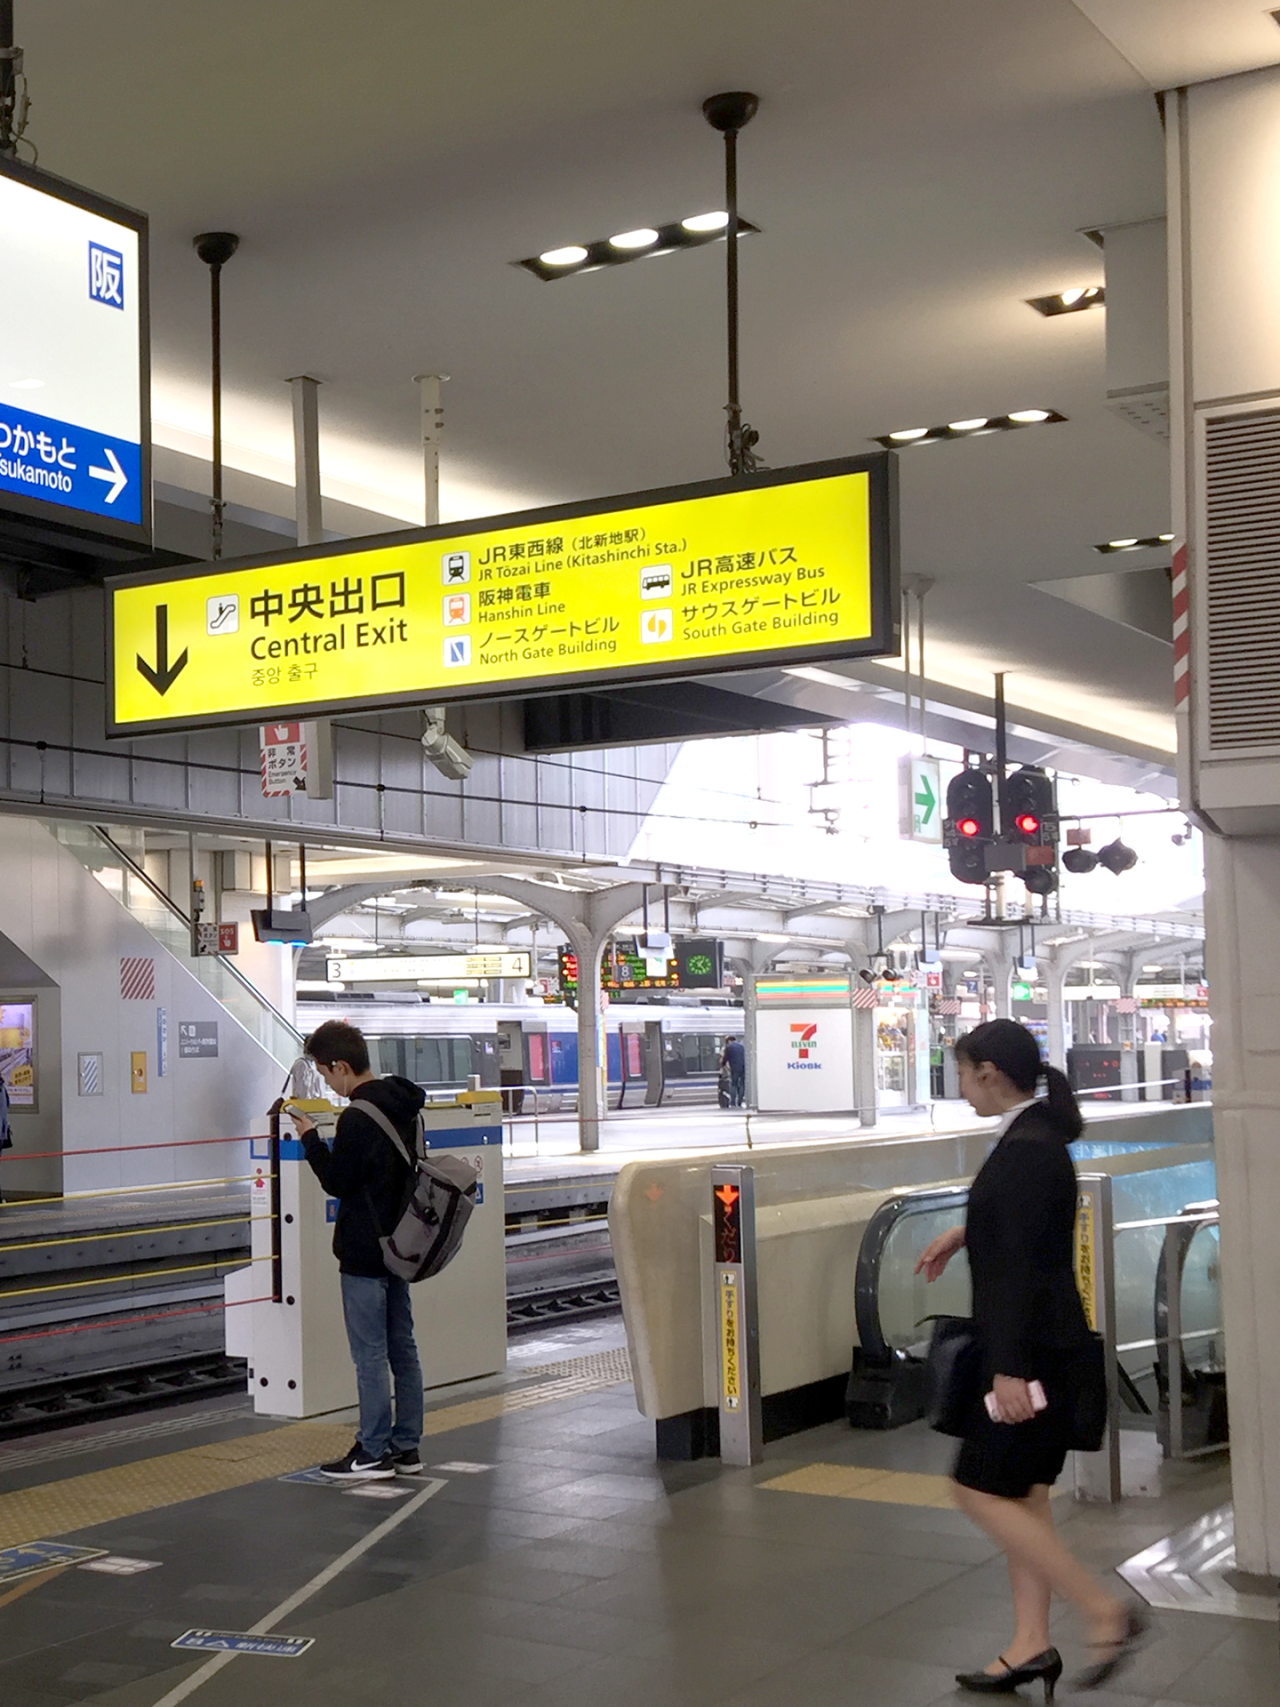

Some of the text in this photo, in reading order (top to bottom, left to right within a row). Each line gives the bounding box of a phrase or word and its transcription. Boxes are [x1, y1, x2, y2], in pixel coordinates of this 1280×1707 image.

[91, 247, 123, 305] 阪
[478, 538, 687, 582] JR Tōzai Line (Kitashinchi Sta.)
[680, 547, 798, 579] JR高速バス
[478, 582, 551, 608] 阪神電車
[681, 566, 825, 597] JR Expressway Bus
[250, 571, 406, 627] 中央出口
[478, 601, 566, 623] Hanshin Line
[681, 587, 841, 623] サウスゲートビル
[250, 617, 408, 660] Central Exit
[479, 616, 620, 649] ノースゲートビル
[683, 611, 839, 641] South Gate Building
[479, 637, 617, 665] North Gate Building
[251, 662, 319, 686] 중앙 출구
[268, 758, 296, 770] ボタン
[332, 962, 341, 978] 3
[512, 957, 523, 973] 4
[621, 966, 629, 978] 8
[787, 1061, 822, 1070] Kiosk
[725, 1290, 737, 1394] 手すりをお持ちください
